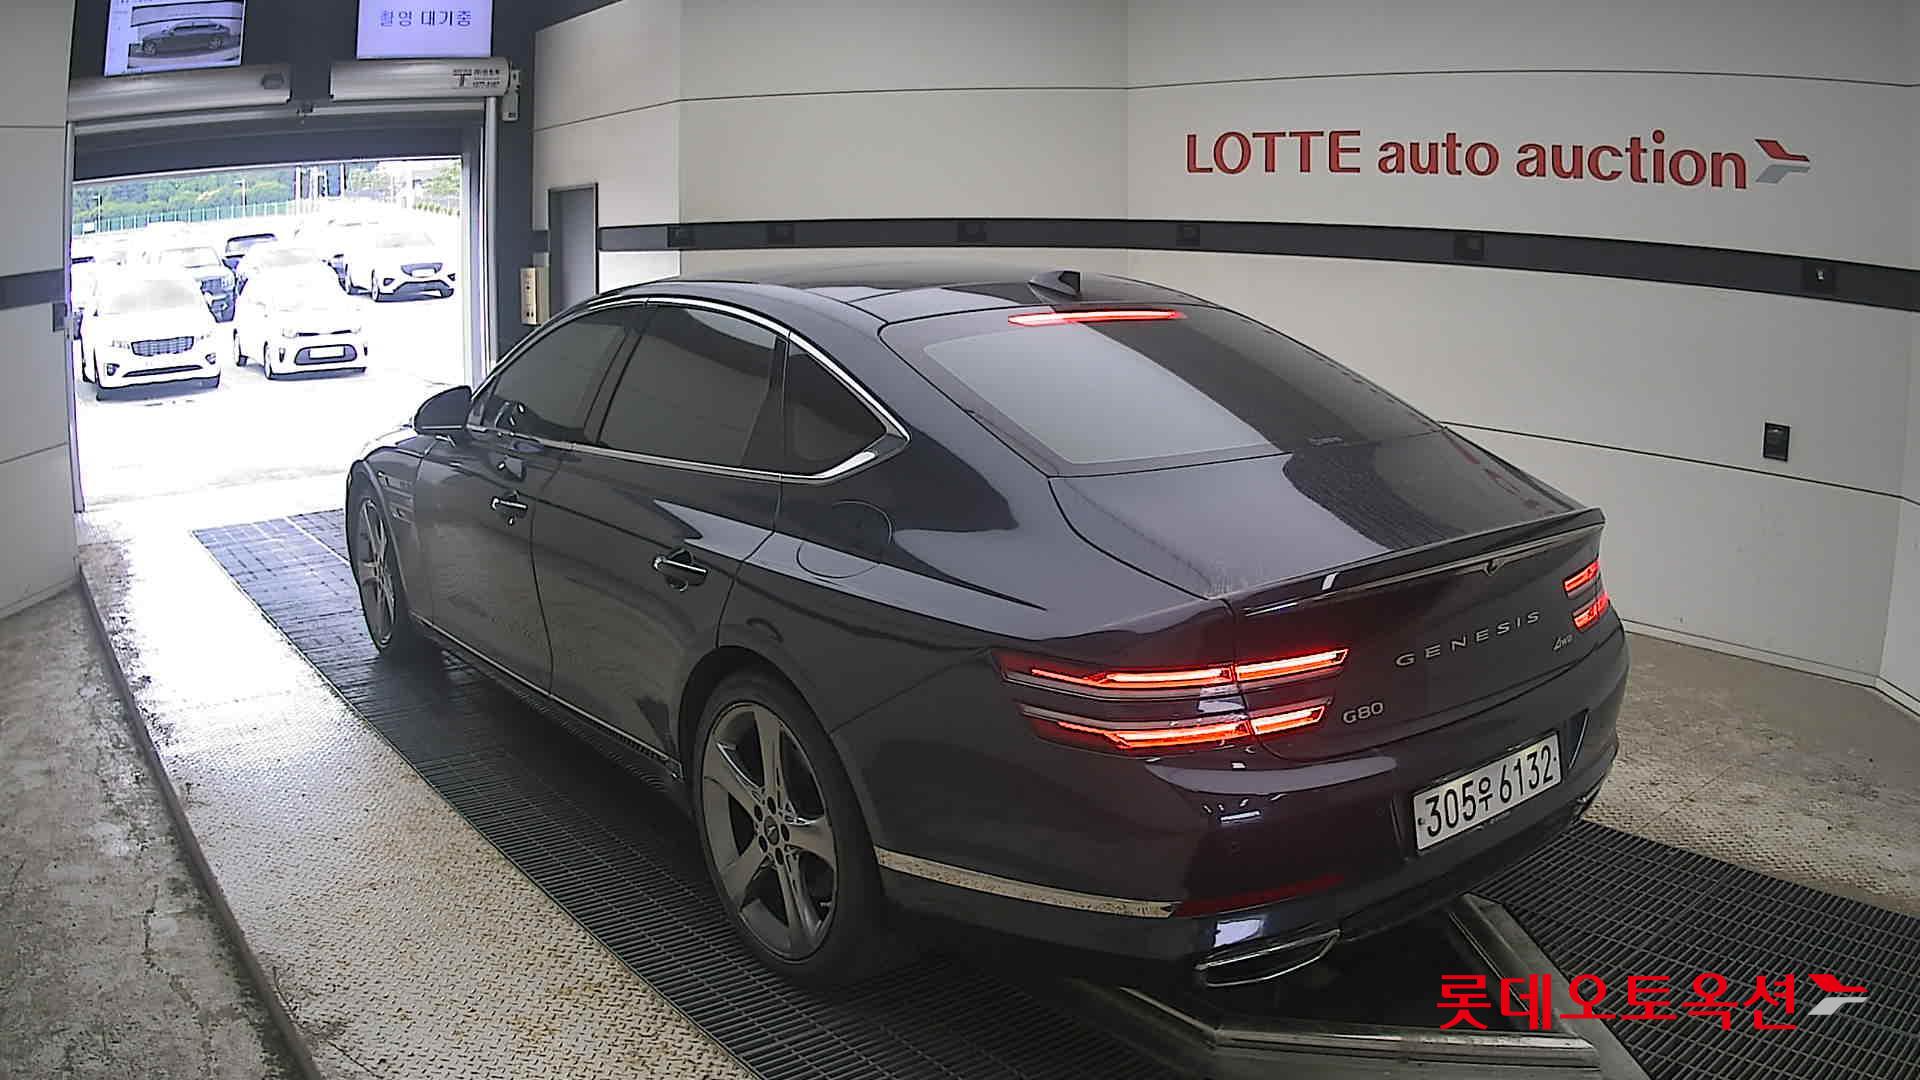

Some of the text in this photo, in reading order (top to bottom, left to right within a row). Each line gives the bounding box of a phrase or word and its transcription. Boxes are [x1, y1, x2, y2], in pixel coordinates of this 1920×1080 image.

[421, 10, 472, 27] 대기중
[1186, 129, 1747, 189] LOTTE auto auction
[1395, 611, 1540, 667] GENESIS
[1342, 702, 1384, 724] G80
